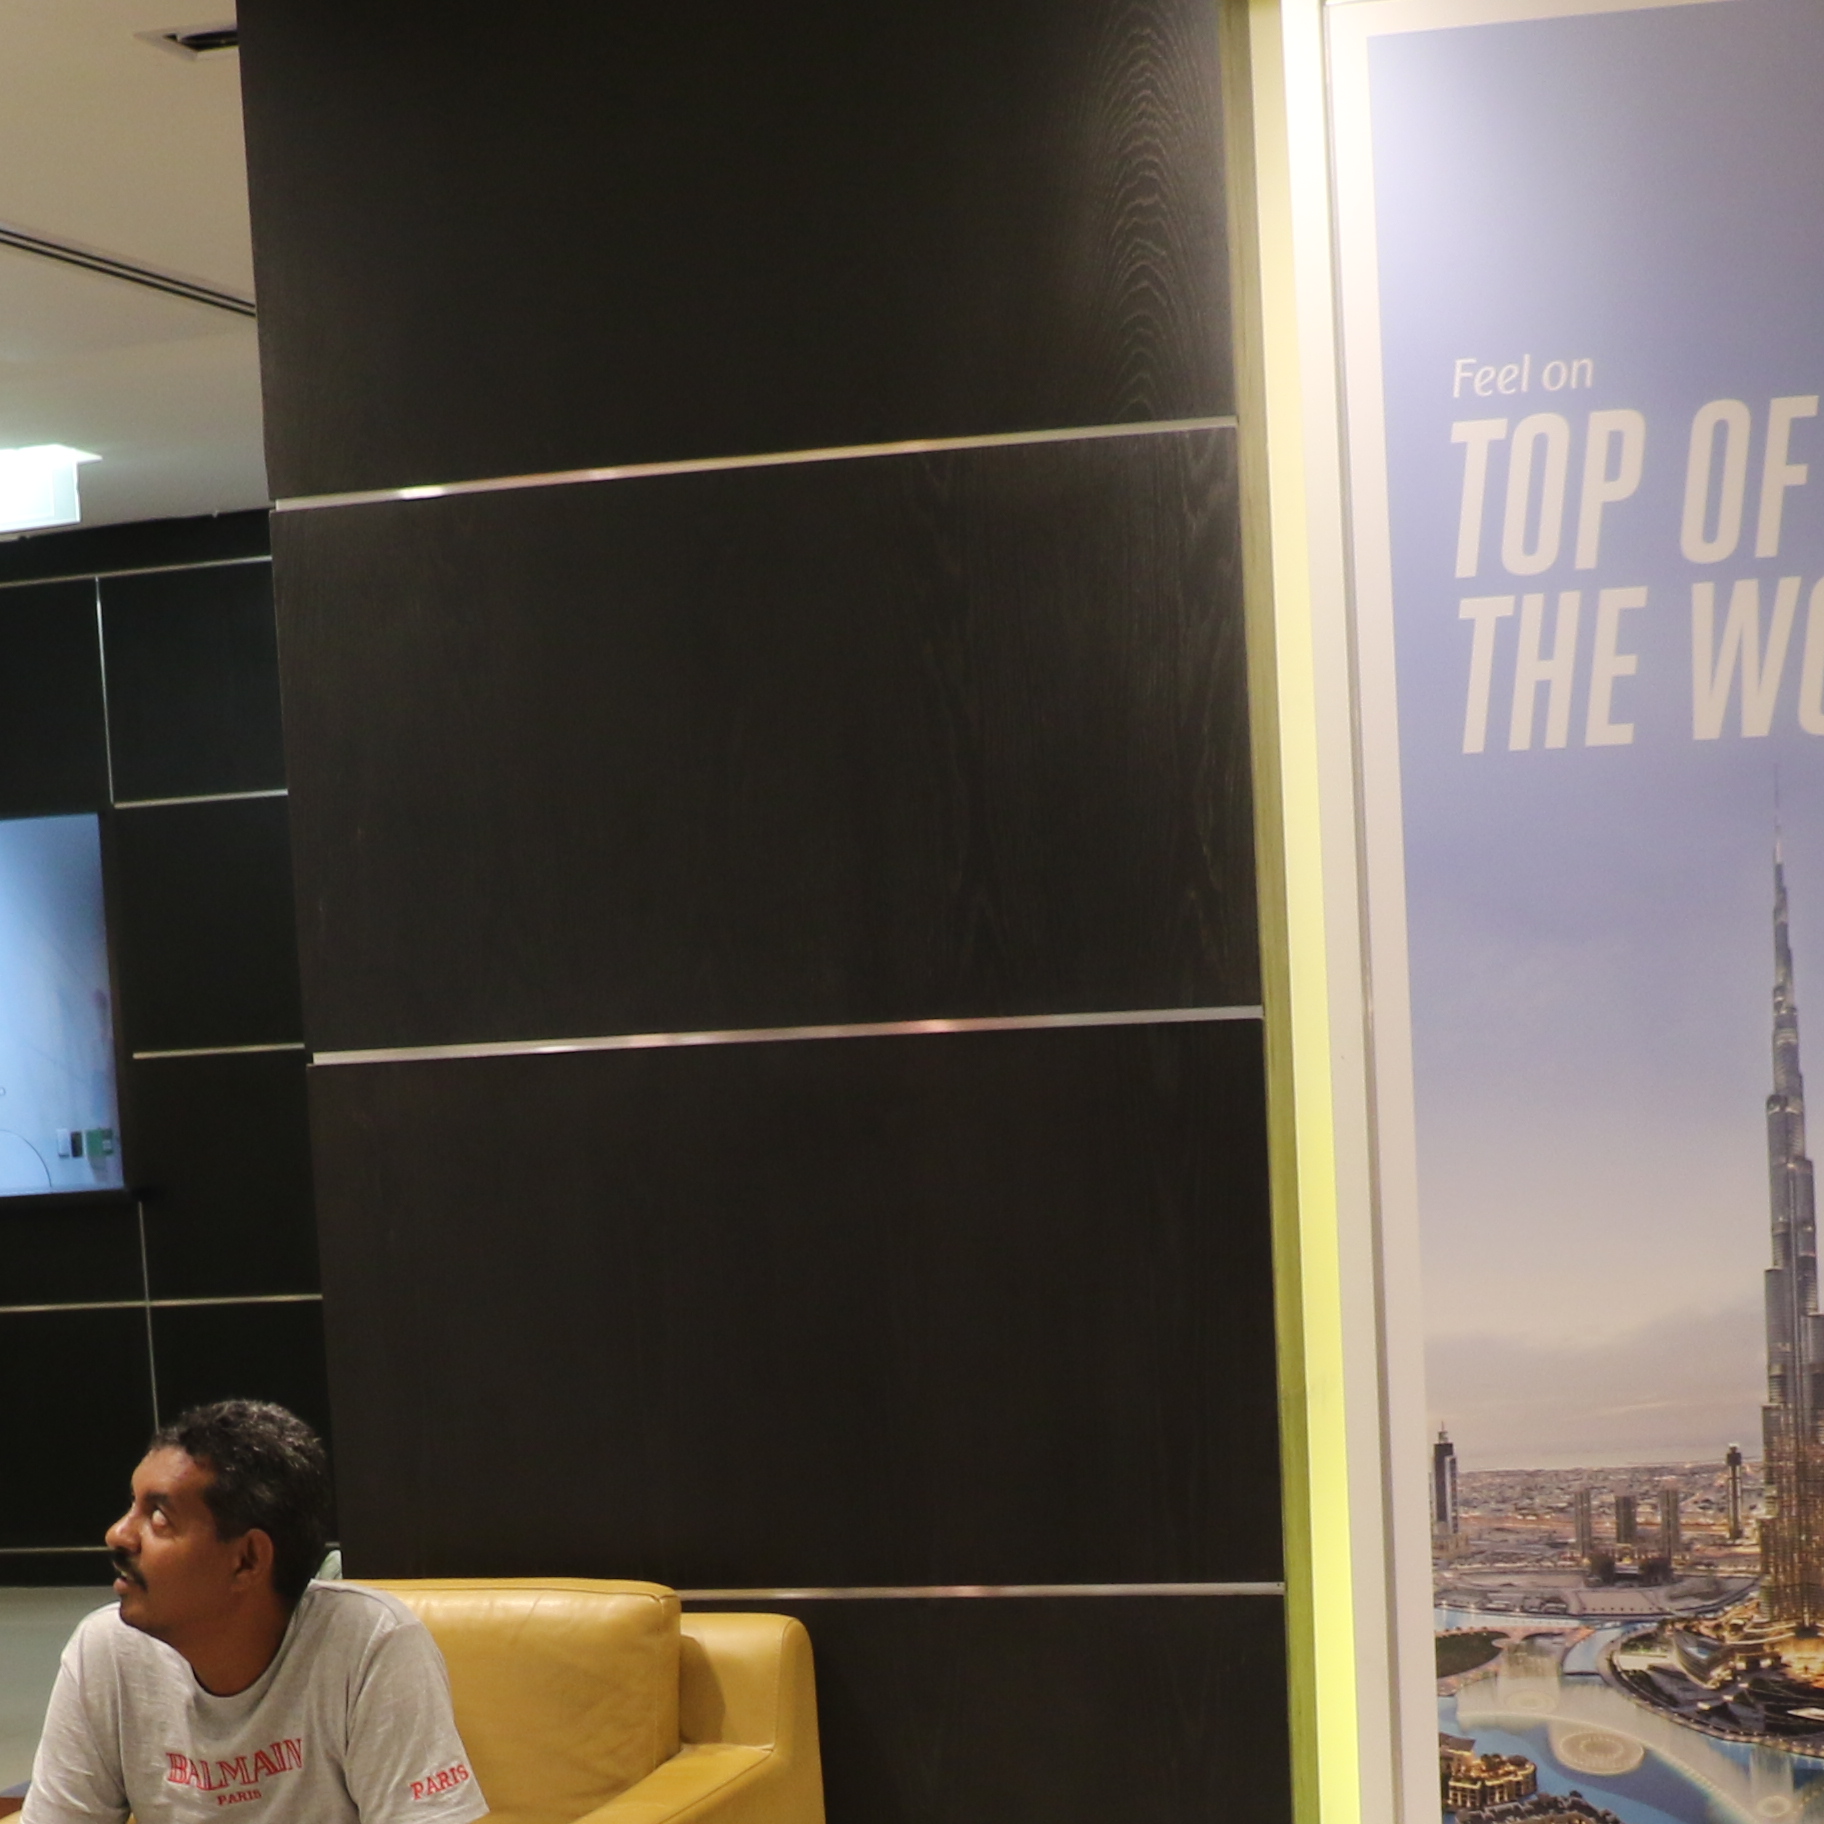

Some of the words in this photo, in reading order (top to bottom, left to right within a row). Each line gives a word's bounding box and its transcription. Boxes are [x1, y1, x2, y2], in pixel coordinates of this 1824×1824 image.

[1453, 354, 1530, 398] Feel
[1542, 357, 1594, 391] on
[1450, 408, 1646, 578] TOP
[1680, 395, 1819, 564] OF
[1458, 586, 1648, 754] THE
[165, 1738, 303, 1791] BALMAIN
[410, 1764, 470, 1800] PARIS
[217, 1789, 262, 1806] PARIS
